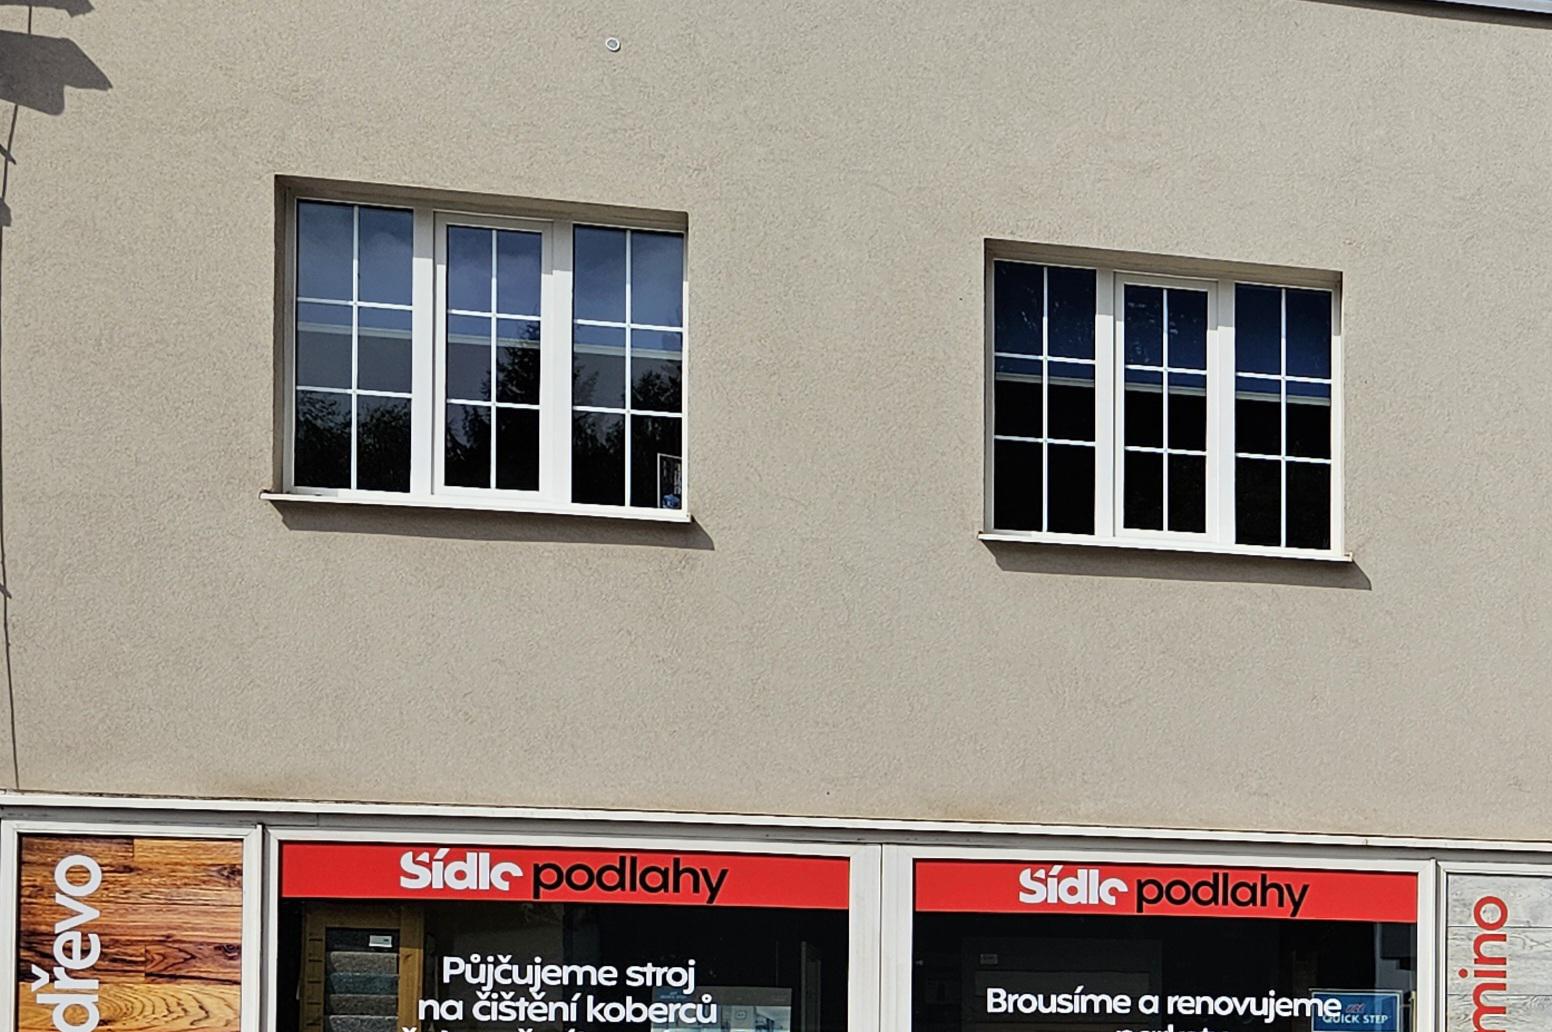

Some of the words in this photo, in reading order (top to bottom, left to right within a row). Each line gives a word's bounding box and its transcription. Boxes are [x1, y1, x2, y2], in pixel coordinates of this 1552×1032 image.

[533, 856, 729, 905] podlahy
[1136, 872, 1310, 918] podlahy
[442, 954, 617, 993] Půjčujeme
[625, 959, 696, 994] stroj
[418, 997, 465, 1021] na
[472, 990, 580, 1023] čištění
[586, 993, 718, 1024] koberců
[986, 985, 1131, 1014] Brousíme
[1138, 996, 1160, 1015] a
[1167, 990, 1341, 1024] renovujeme
